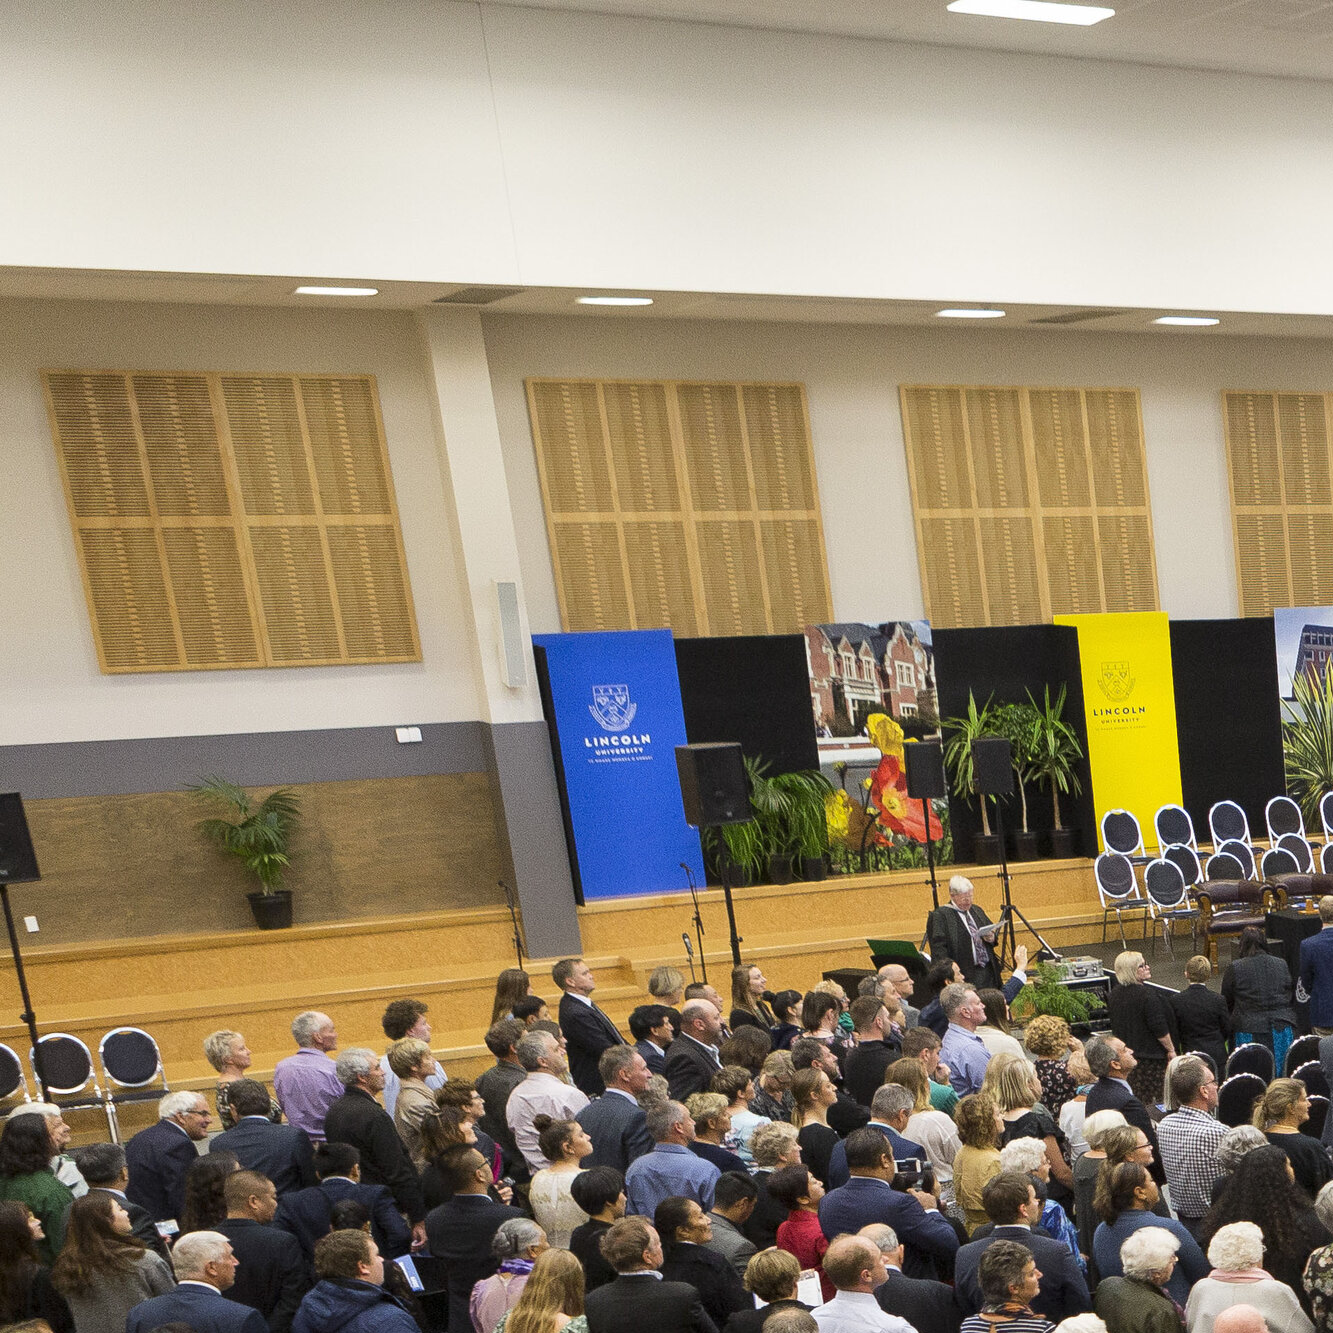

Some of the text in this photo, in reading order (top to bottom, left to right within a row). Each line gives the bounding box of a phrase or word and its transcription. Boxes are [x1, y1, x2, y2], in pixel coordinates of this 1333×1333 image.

[1093, 706, 1146, 717] LINCOLN
[1101, 717, 1140, 725] UNIVERSITY
[584, 733, 651, 748] LINCOLN
[595, 746, 644, 756] UNIVERSITY
